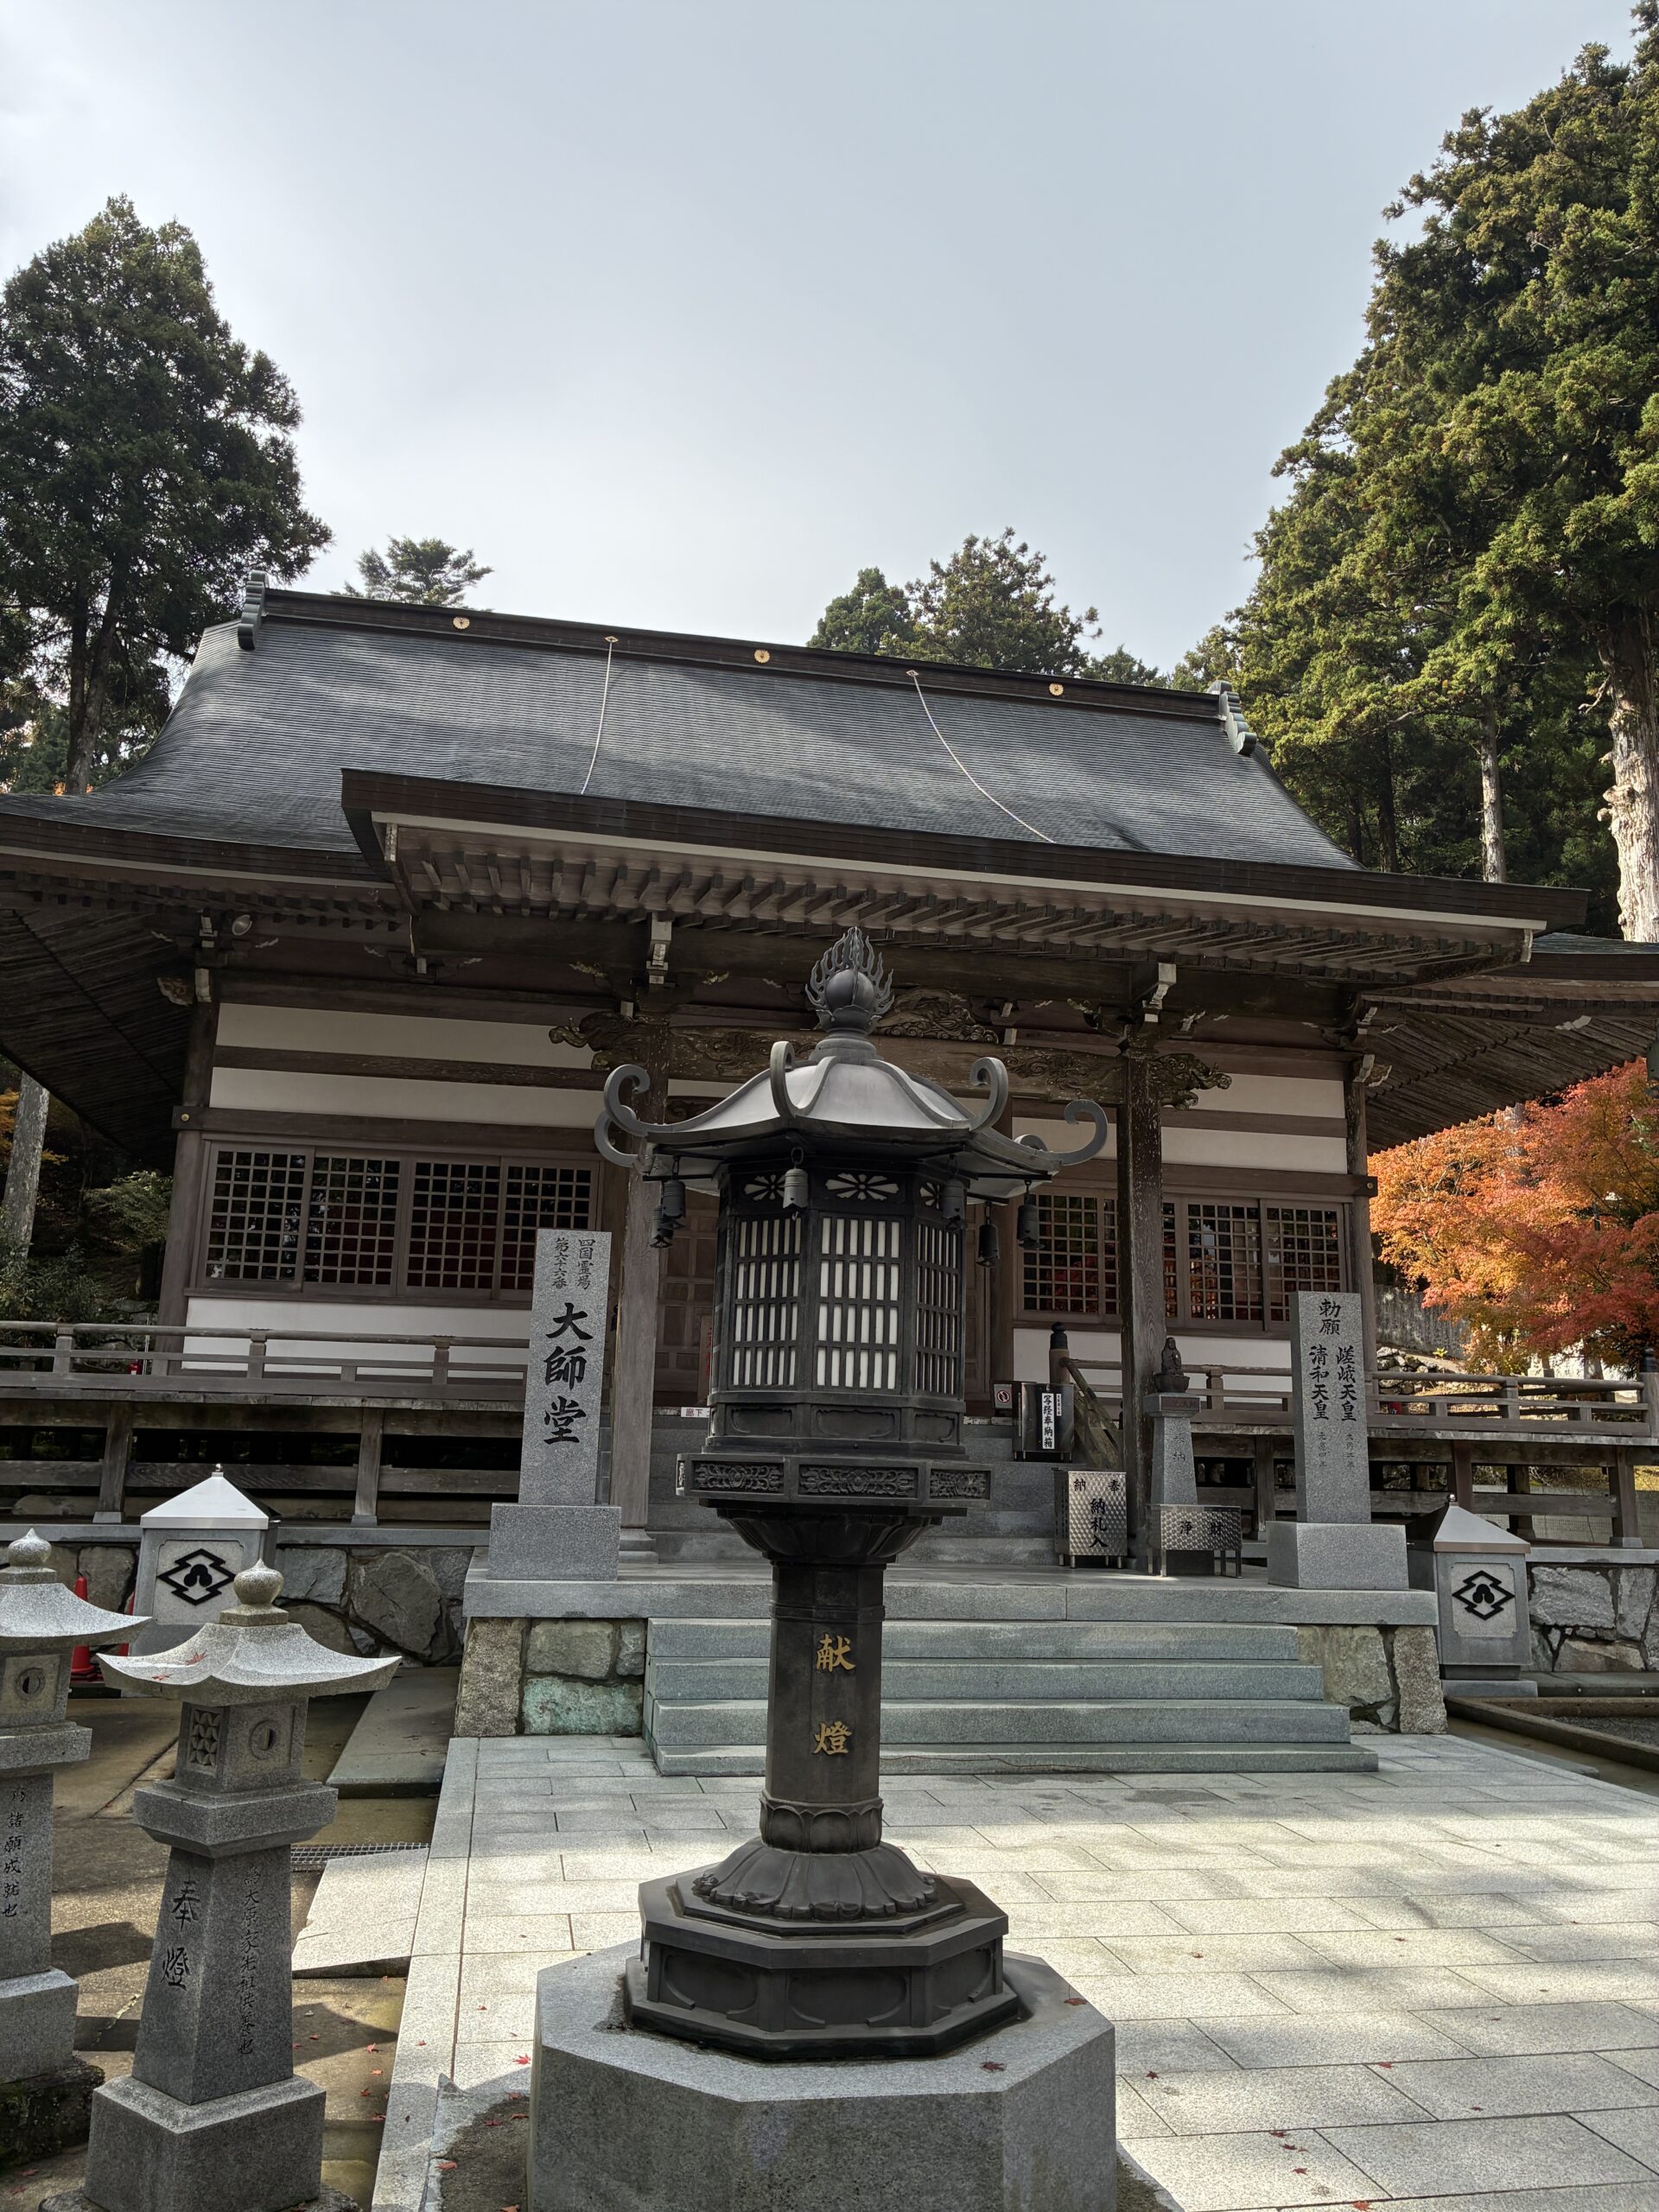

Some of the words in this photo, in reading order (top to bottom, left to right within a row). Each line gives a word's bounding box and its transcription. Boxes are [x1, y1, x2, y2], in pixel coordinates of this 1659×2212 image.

[551, 1236, 569, 1289] 第六十六番
[577, 1237, 595, 1290] 四国霊場
[1319, 1298, 1341, 1335] 勅願
[543, 1302, 594, 1445] 大師堂
[1308, 1344, 1330, 1421] 清和天皇
[1336, 1345, 1357, 1421] 嵯峨天皇
[1043, 1395, 1053, 1448] 写経奉納箱
[1090, 1498, 1109, 1548] 納札入
[812, 1633, 856, 1756] 献燈
[160, 1880, 201, 1991] 奉燈
